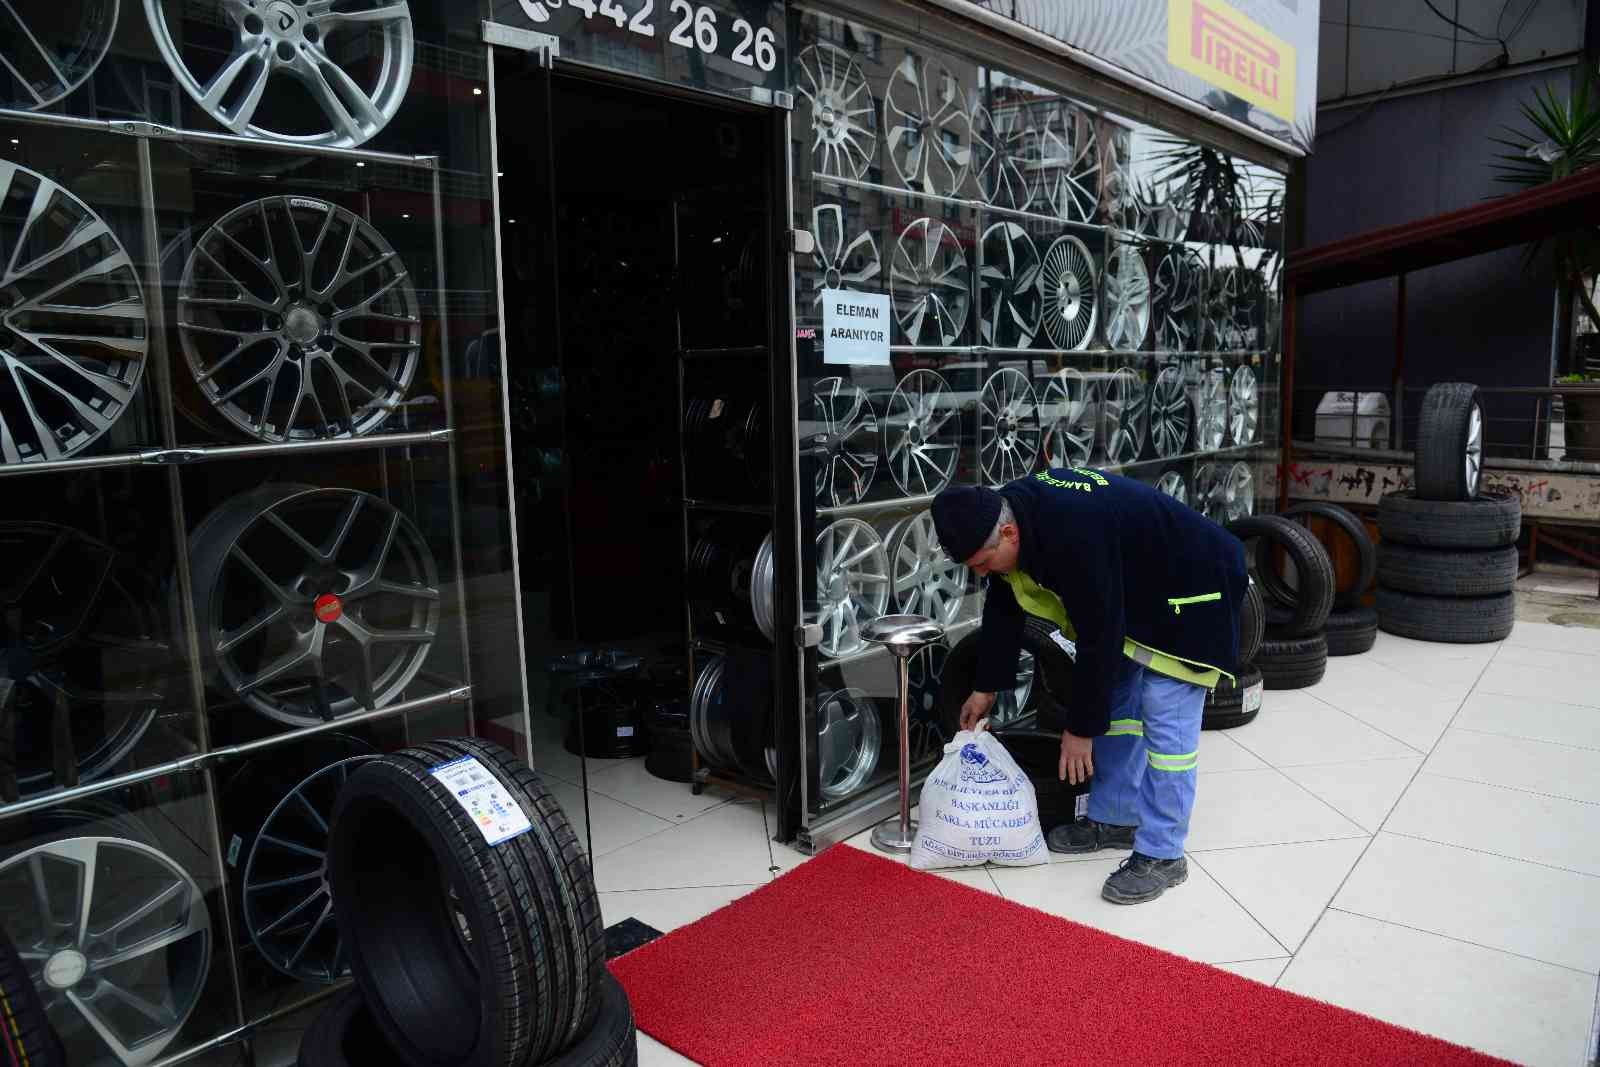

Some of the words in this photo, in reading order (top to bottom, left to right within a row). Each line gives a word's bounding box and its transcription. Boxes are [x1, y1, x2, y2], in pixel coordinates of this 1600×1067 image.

[669, 0, 718, 53] 26
[731, 18, 776, 72] 26
[1191, 0, 1280, 101] PIRELLI
[836, 303, 879, 319] ELEMAN
[830, 327, 884, 342] ARANIYOR
[969, 836, 1001, 846] TUZU
